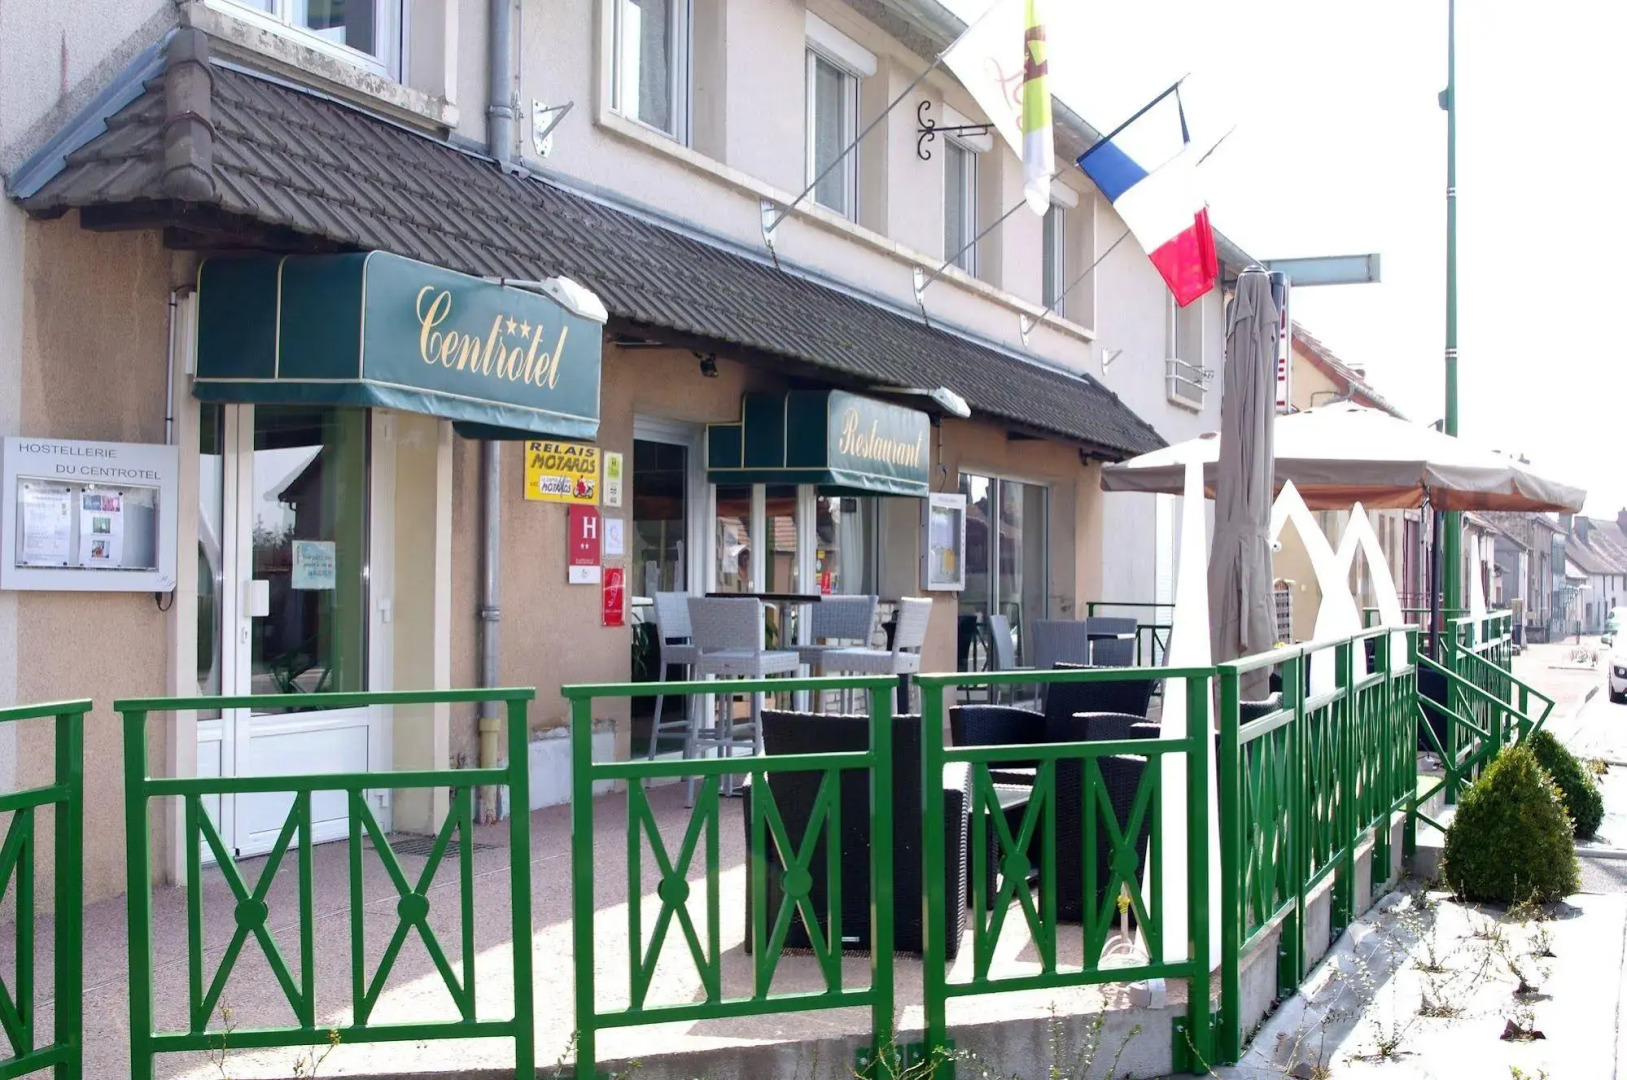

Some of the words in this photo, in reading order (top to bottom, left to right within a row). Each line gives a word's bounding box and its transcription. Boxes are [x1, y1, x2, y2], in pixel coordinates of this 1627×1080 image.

[416, 285, 569, 390] Centrotel
[839, 406, 923, 468] Restaurant
[19, 443, 117, 459] HOSTELLERIE
[530, 442, 595, 458] RELAIS
[56, 464, 76, 474] DU
[80, 465, 161, 480] CENTROTEL
[530, 453, 596, 474] MOTARDS
[583, 516, 597, 539] H
